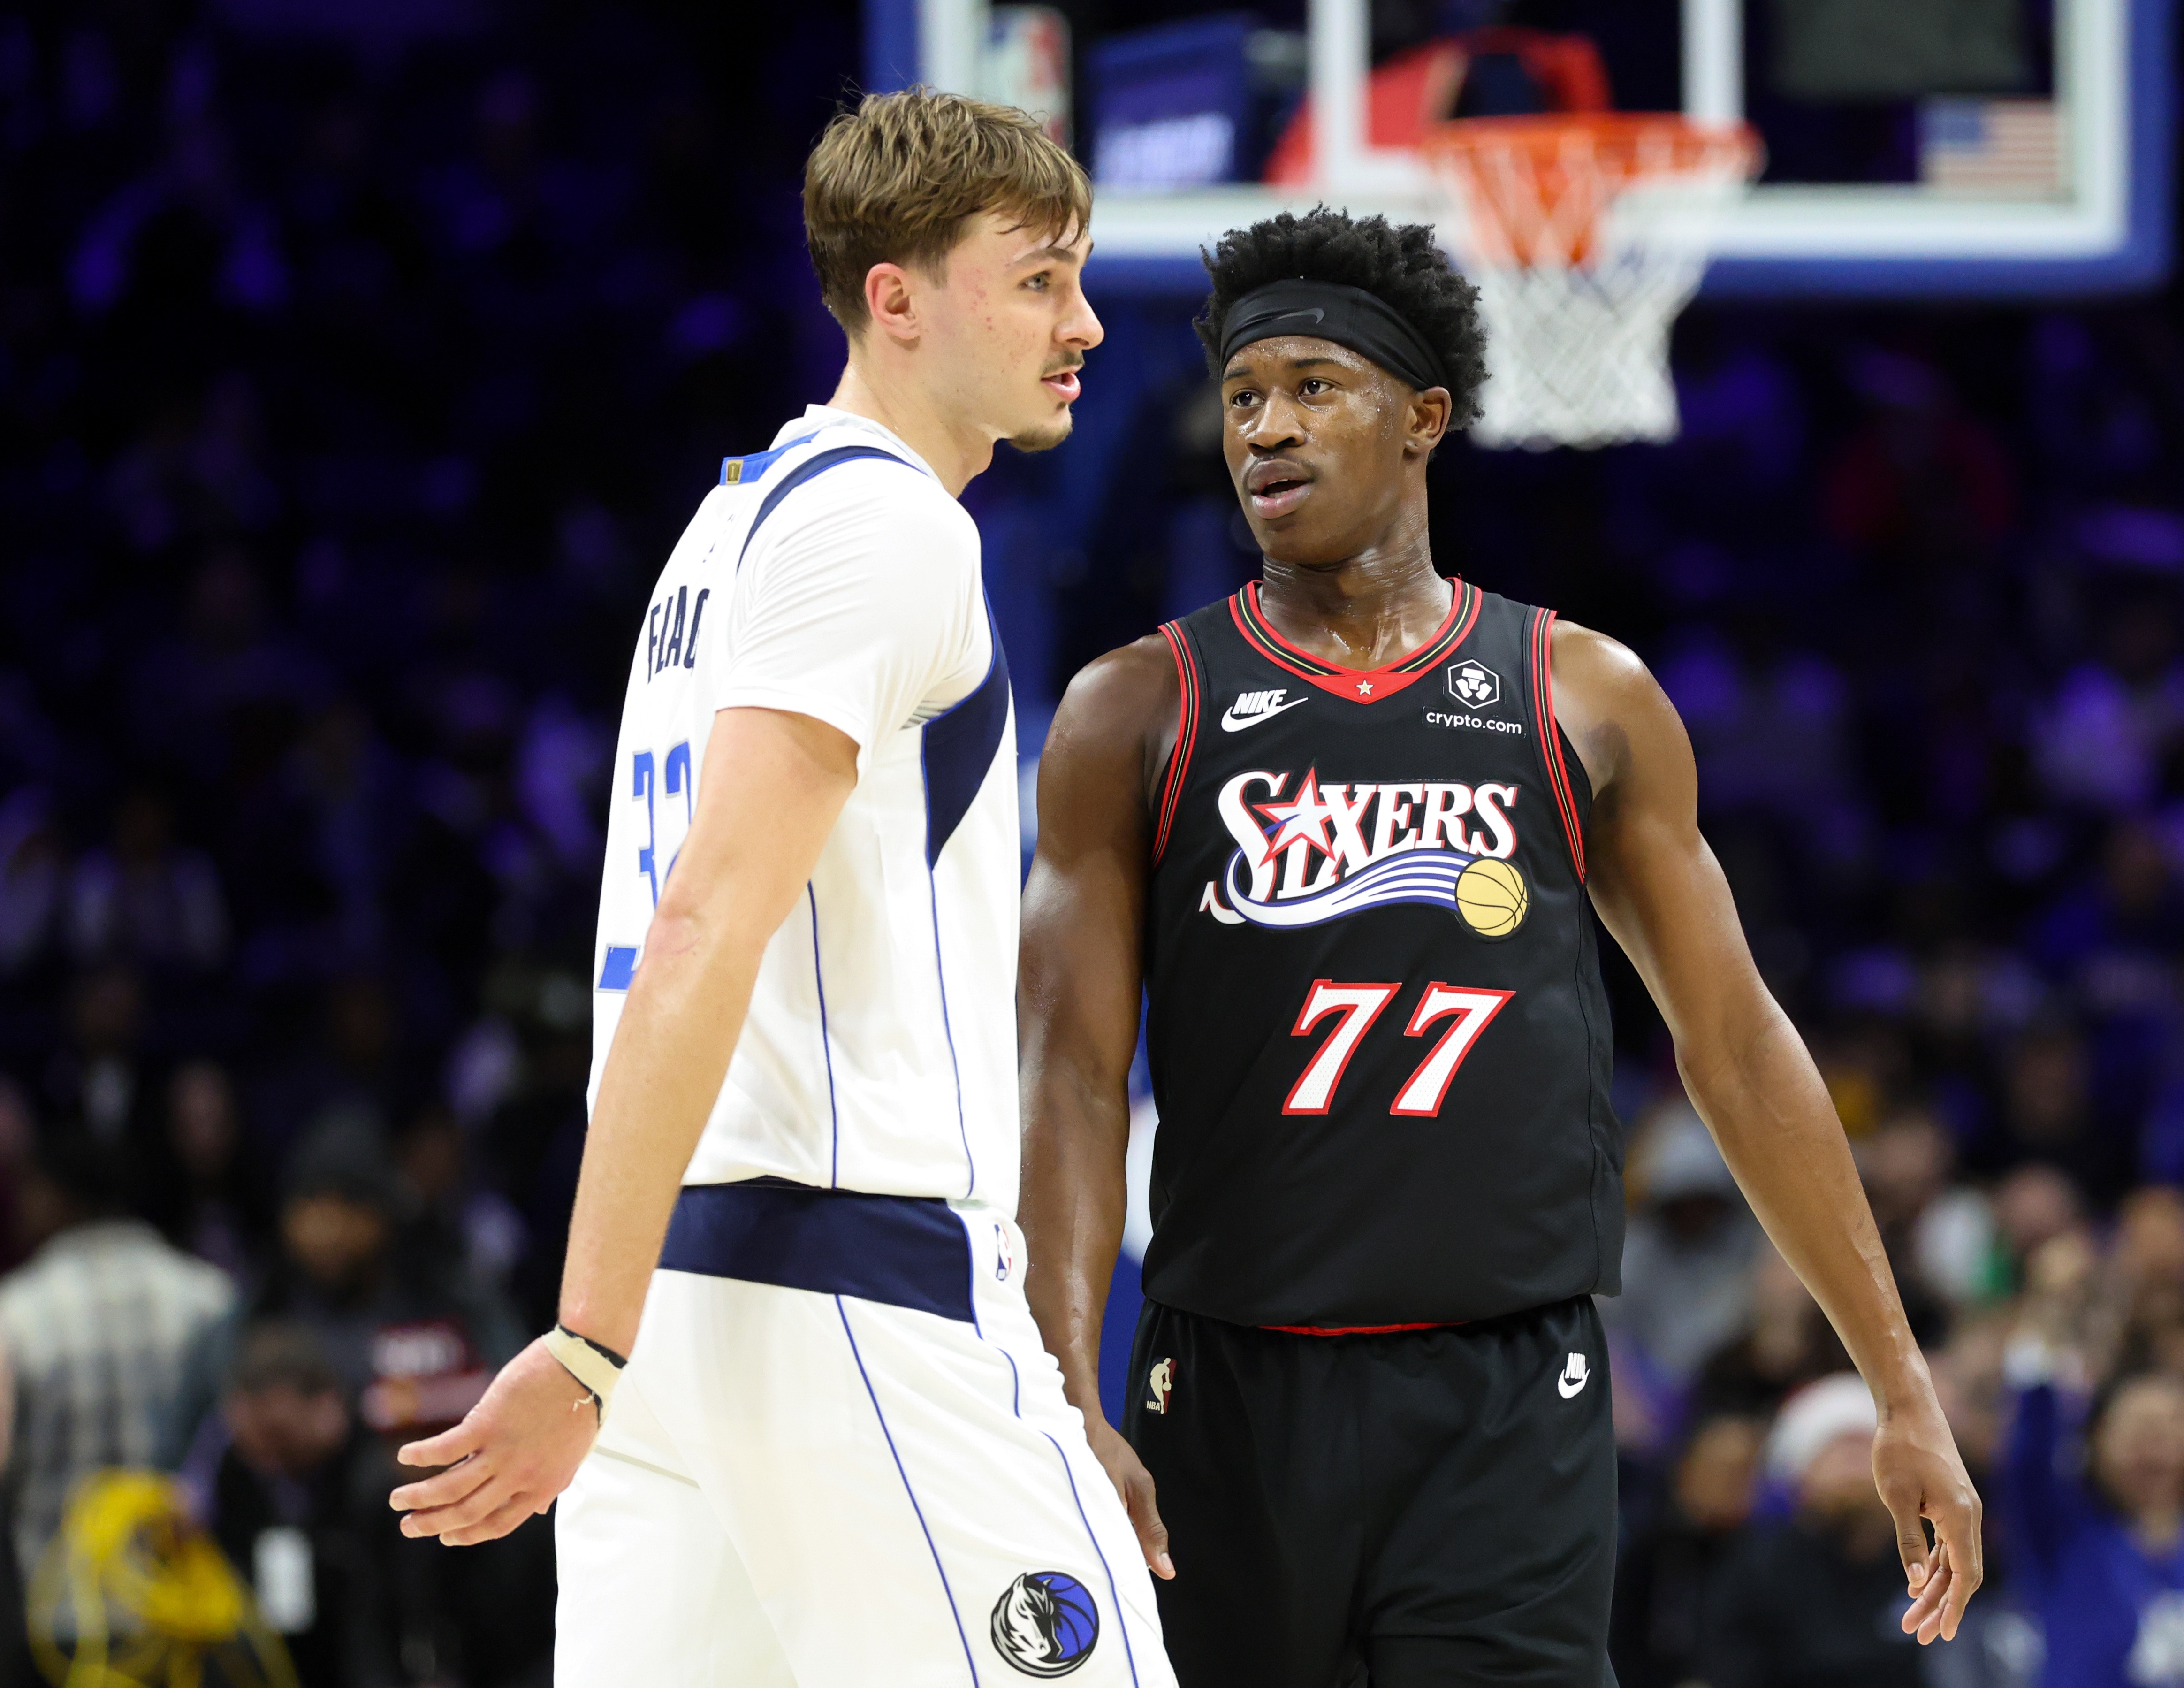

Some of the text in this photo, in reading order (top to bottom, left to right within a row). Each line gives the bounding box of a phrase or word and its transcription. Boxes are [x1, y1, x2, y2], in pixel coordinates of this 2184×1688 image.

[1232, 689, 1287, 714] NIKE
[1426, 712, 1522, 734] crypto.com
[1282, 979, 1516, 1117] 77
[1147, 1401, 1160, 1411] NBA
